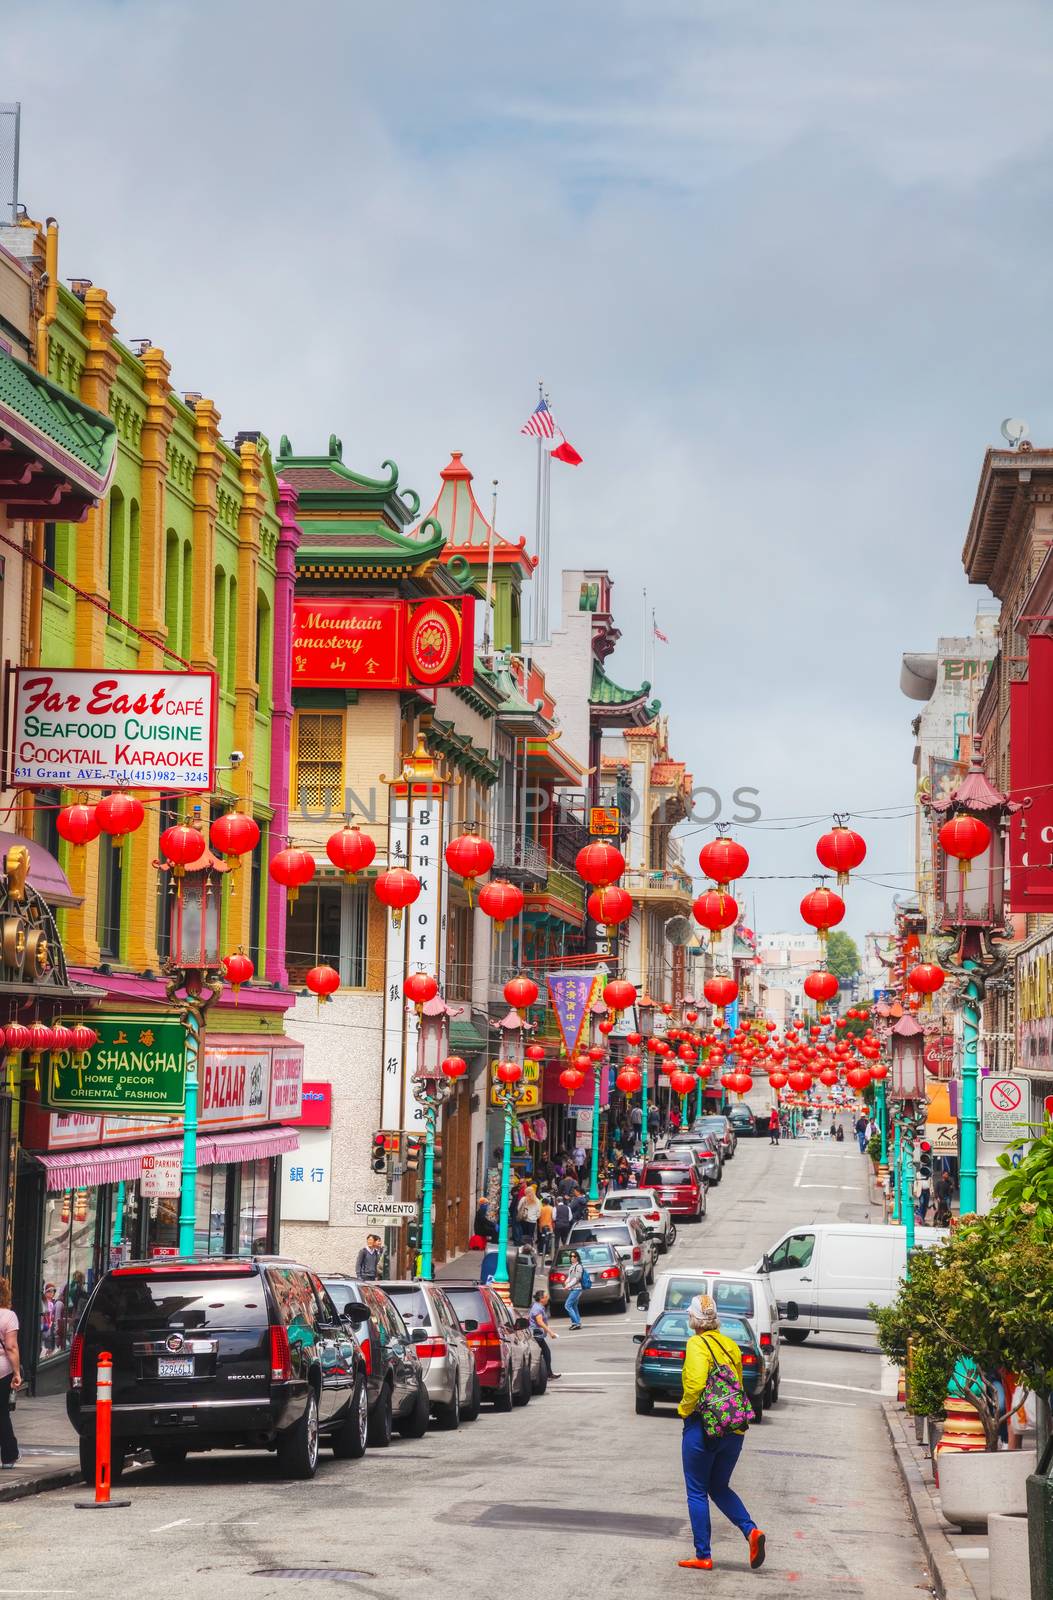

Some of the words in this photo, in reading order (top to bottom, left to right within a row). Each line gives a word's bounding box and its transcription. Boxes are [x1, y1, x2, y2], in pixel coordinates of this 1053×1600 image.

[301, 613, 383, 630] Mountain
[292, 634, 363, 654] onastery
[23, 677, 81, 714] Far
[87, 680, 165, 715] East
[166, 698, 203, 716] CAFÉ
[24, 716, 116, 738] SEAFOOD
[125, 719, 202, 741] CUISINE
[20, 742, 107, 765] COCKTAIL
[115, 744, 204, 767] KARAOKE
[15, 768, 32, 777] 631
[37, 768, 70, 778] Grant
[418, 810, 431, 891] Bank
[417, 914, 428, 950] of
[60, 1050, 91, 1070] OLD
[97, 1050, 183, 1073] SHANGHAI
[84, 1075, 113, 1083] HOME
[120, 1076, 154, 1084] DECOR
[115, 1083, 122, 1091] &
[203, 1066, 246, 1109] BAZAAR
[71, 1090, 119, 1098] ORIENTAL
[125, 1091, 168, 1099] FASHION
[143, 1157, 154, 1168] NO
[155, 1160, 180, 1168] PARKING
[289, 1167, 324, 1183] 銀行
[356, 1203, 414, 1214] SACRAMENTO
